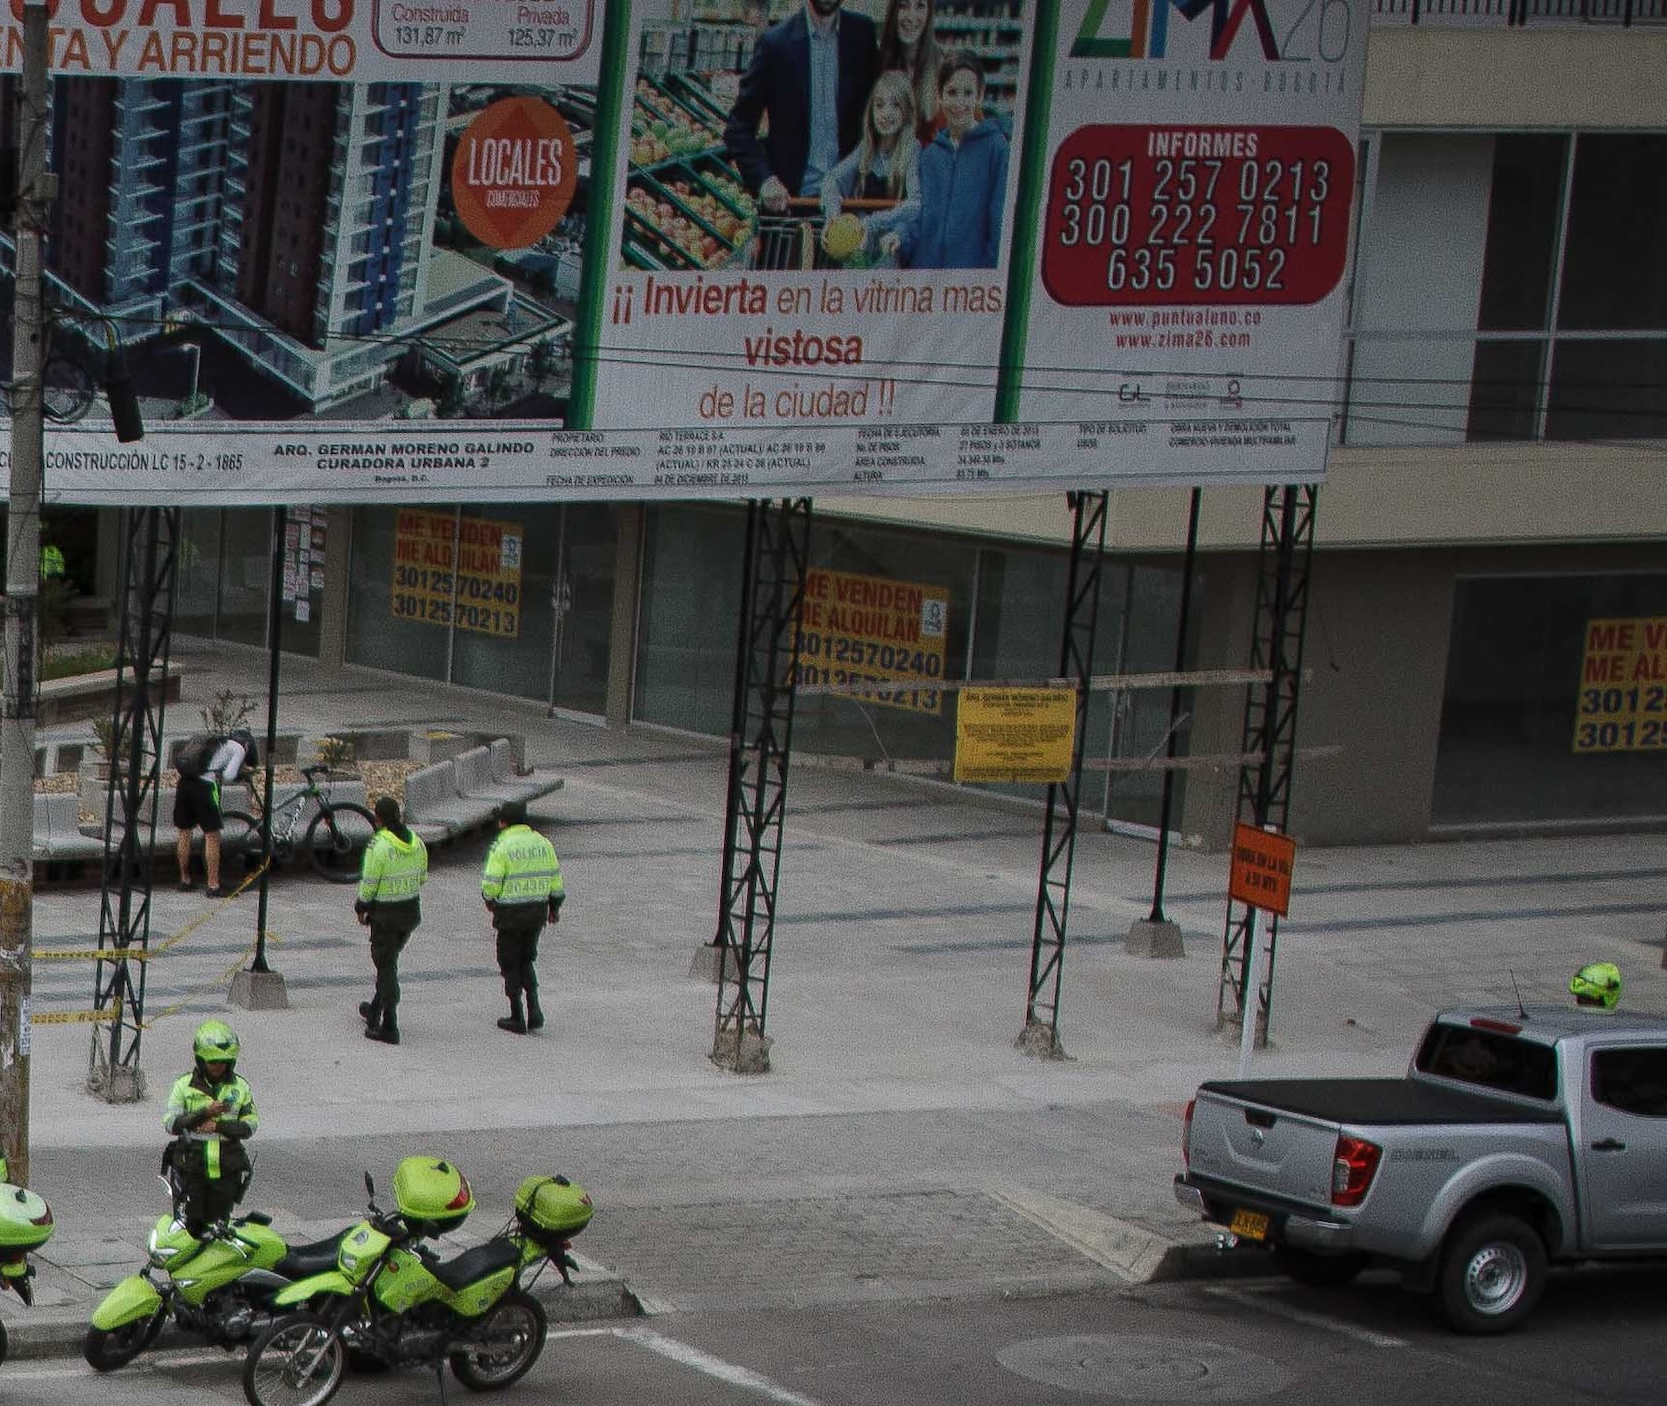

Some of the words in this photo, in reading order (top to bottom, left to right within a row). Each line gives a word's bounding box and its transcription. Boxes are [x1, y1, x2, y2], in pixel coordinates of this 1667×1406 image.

[391, 4, 469, 24] Construida
[518, 6, 571, 26] Privada
[102, 28, 131, 72] Y
[138, 30, 357, 76] ARRIENDO
[467, 137, 563, 187] LOCALES
[1147, 131, 1260, 158] INFORMES
[1066, 159, 1133, 201] 301
[1153, 160, 1222, 201] 257
[1240, 161, 1330, 202] 0213
[1059, 204, 1131, 246] 300
[1147, 204, 1217, 246] 222
[1236, 204, 1322, 246] 7811
[1107, 249, 1176, 290] 635
[1194, 249, 1287, 290] 5052
[643, 275, 767, 315] Invierta
[777, 286, 811, 314] en
[820, 278, 844, 313] la
[853, 278, 934, 314] vitrina
[942, 285, 1003, 314] mas
[743, 327, 865, 366] vistosa
[699, 384, 734, 418] de
[744, 383, 767, 418] la
[775, 381, 869, 418] ciudad
[151, 452, 169, 471] LC
[173, 453, 187, 471] 15
[197, 453, 206, 471] 2
[215, 453, 244, 472] 1865
[273, 444, 313, 457] ARQ.
[317, 443, 386, 456] GERMAN
[391, 443, 460, 456] MORENO
[464, 442, 536, 455] GALINDO
[316, 457, 405, 470] CURADORA
[409, 457, 476, 470] URBANA
[835, 576, 924, 609] VENDEN
[828, 606, 919, 643] ALQUILAN
[1589, 624, 1635, 651] ME
[1584, 656, 1625, 683] ME
